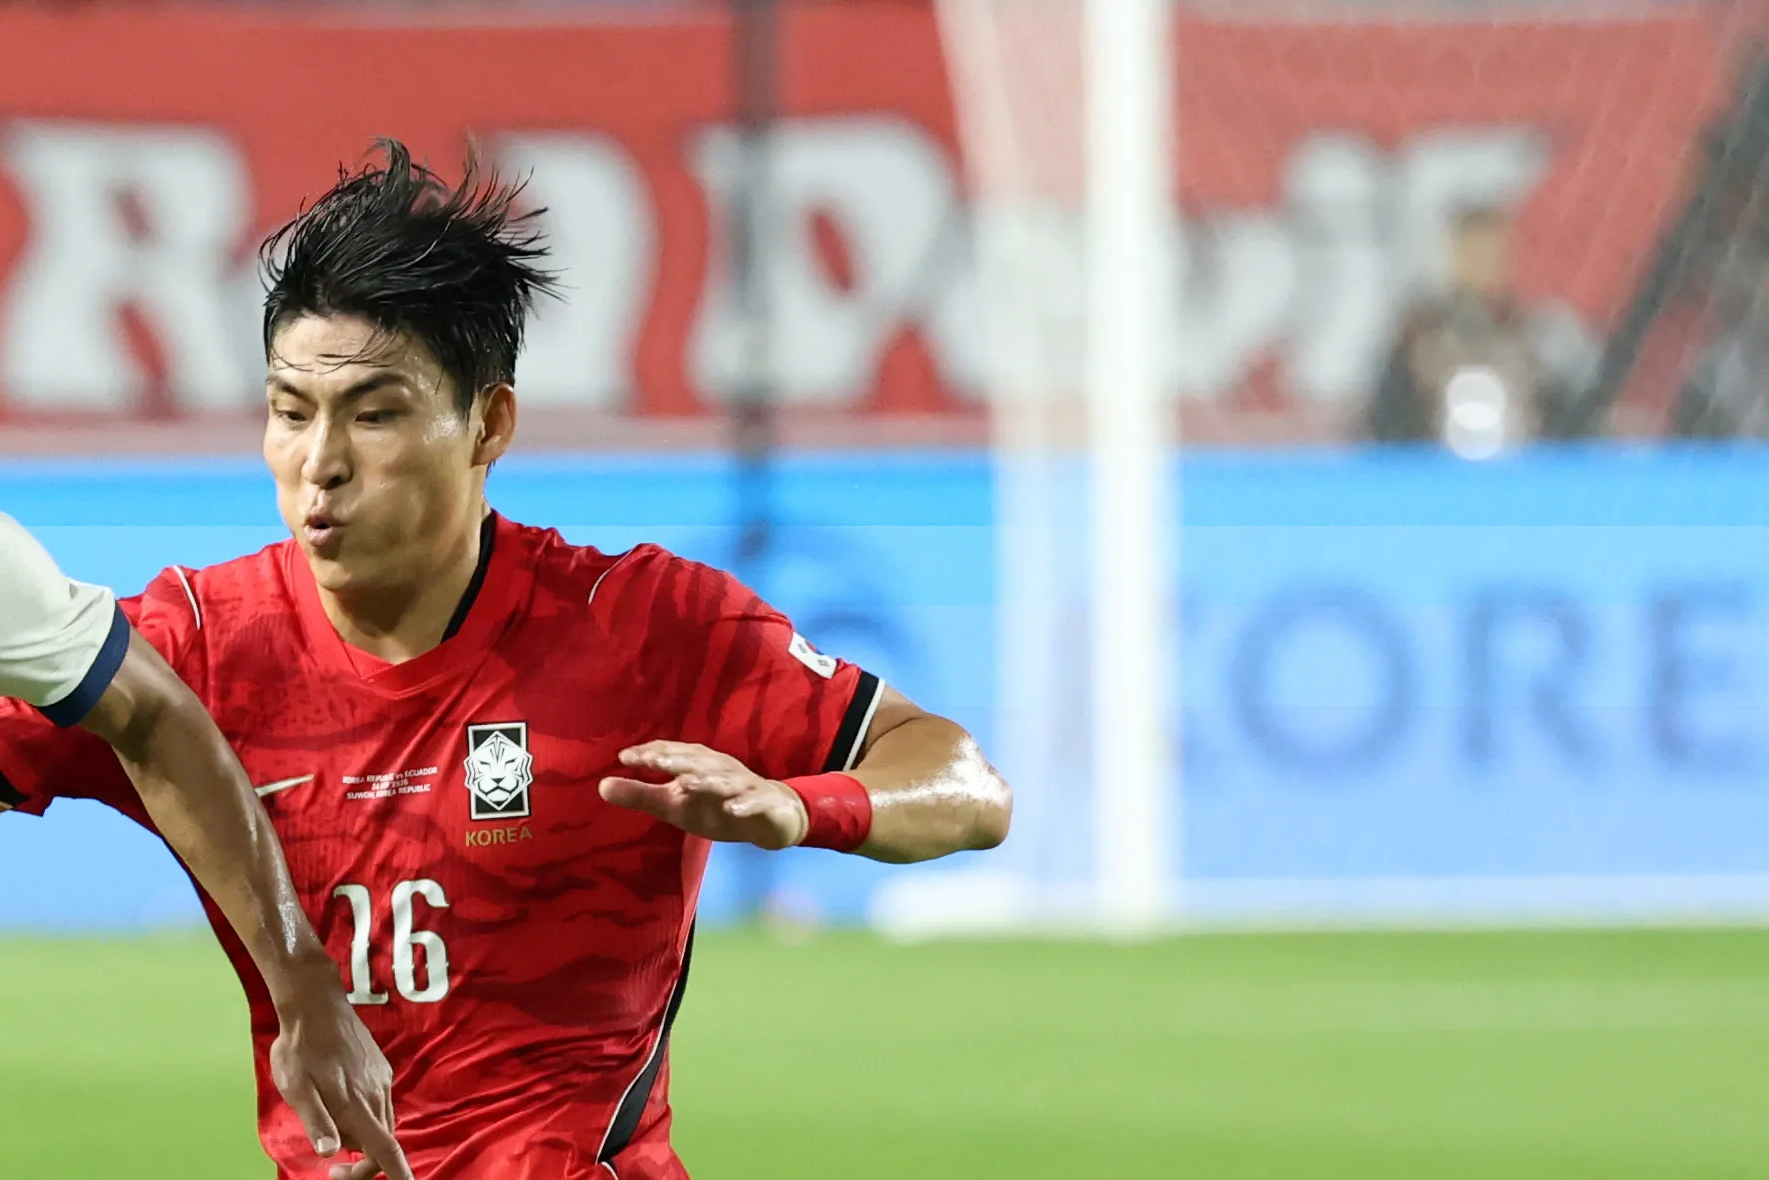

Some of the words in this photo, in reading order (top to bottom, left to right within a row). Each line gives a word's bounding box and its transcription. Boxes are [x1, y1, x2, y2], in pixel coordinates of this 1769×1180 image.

[404, 766, 438, 777] ECUADOR
[465, 826, 533, 848] KOREA
[333, 878, 450, 1005] 16
